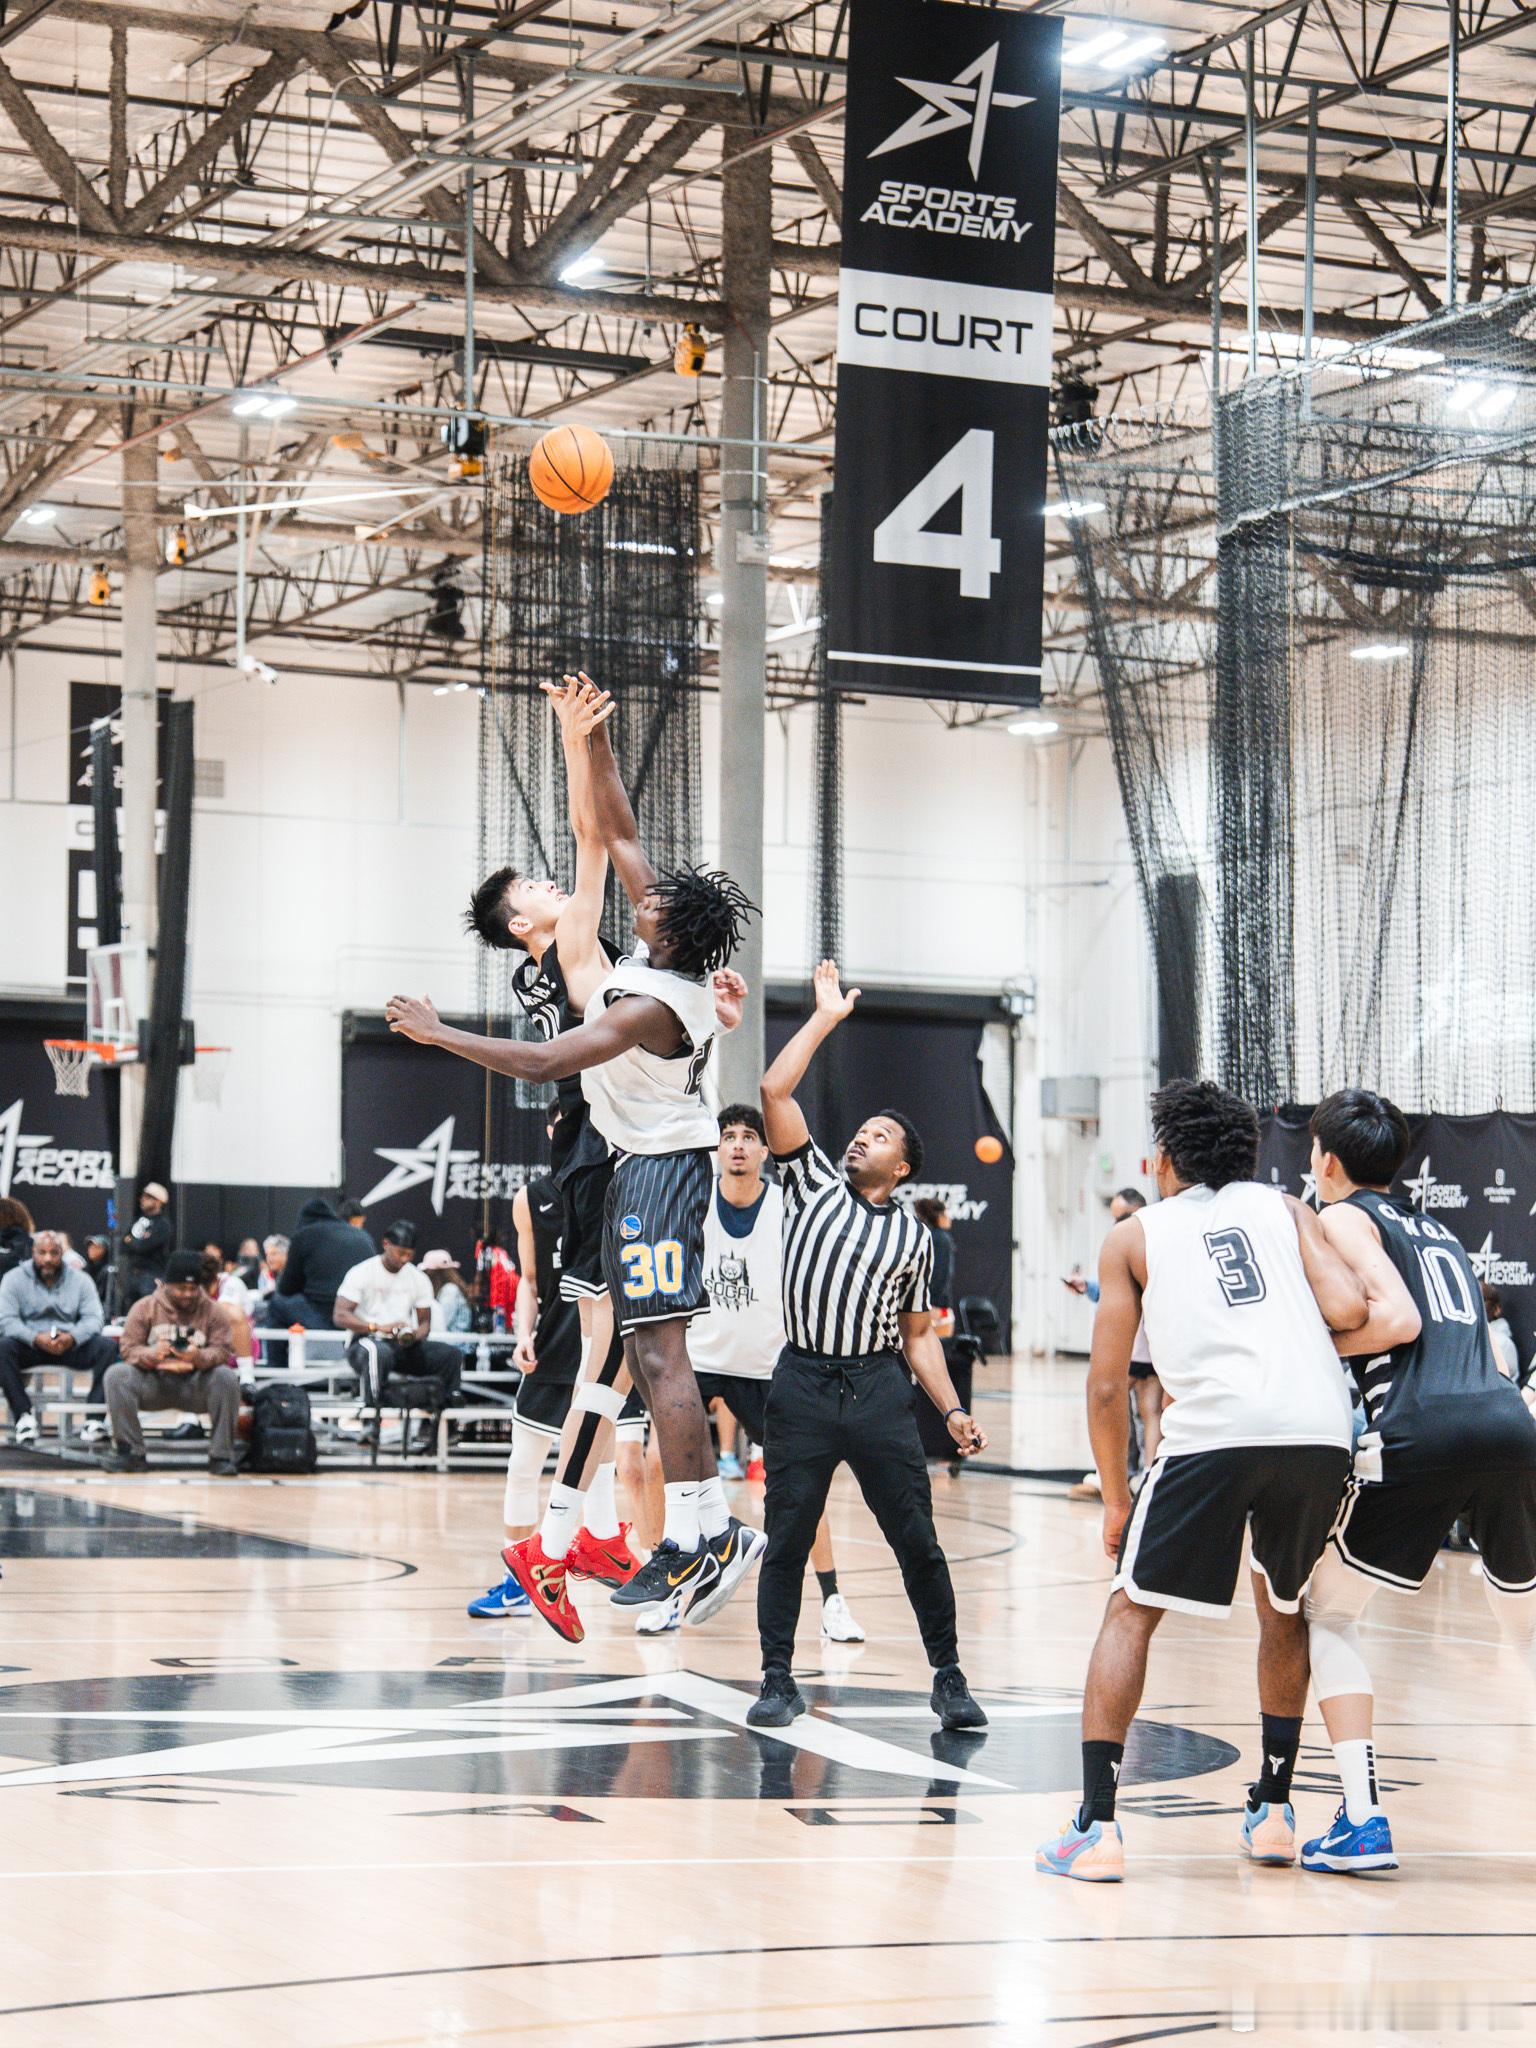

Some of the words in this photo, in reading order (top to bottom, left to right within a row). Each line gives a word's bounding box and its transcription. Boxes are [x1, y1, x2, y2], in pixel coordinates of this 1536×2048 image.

[860, 201, 1033, 243] ACADEMY
[878, 181, 1017, 220] SPORTS
[855, 302, 1033, 355] COURT
[873, 428, 1001, 599] 4
[12, 1167, 117, 1189] ACADE
[17, 1148, 112, 1169] SPORT
[620, 1238, 685, 1300] 30
[1204, 1226, 1266, 1307] 3
[1413, 1244, 1478, 1325] 10
